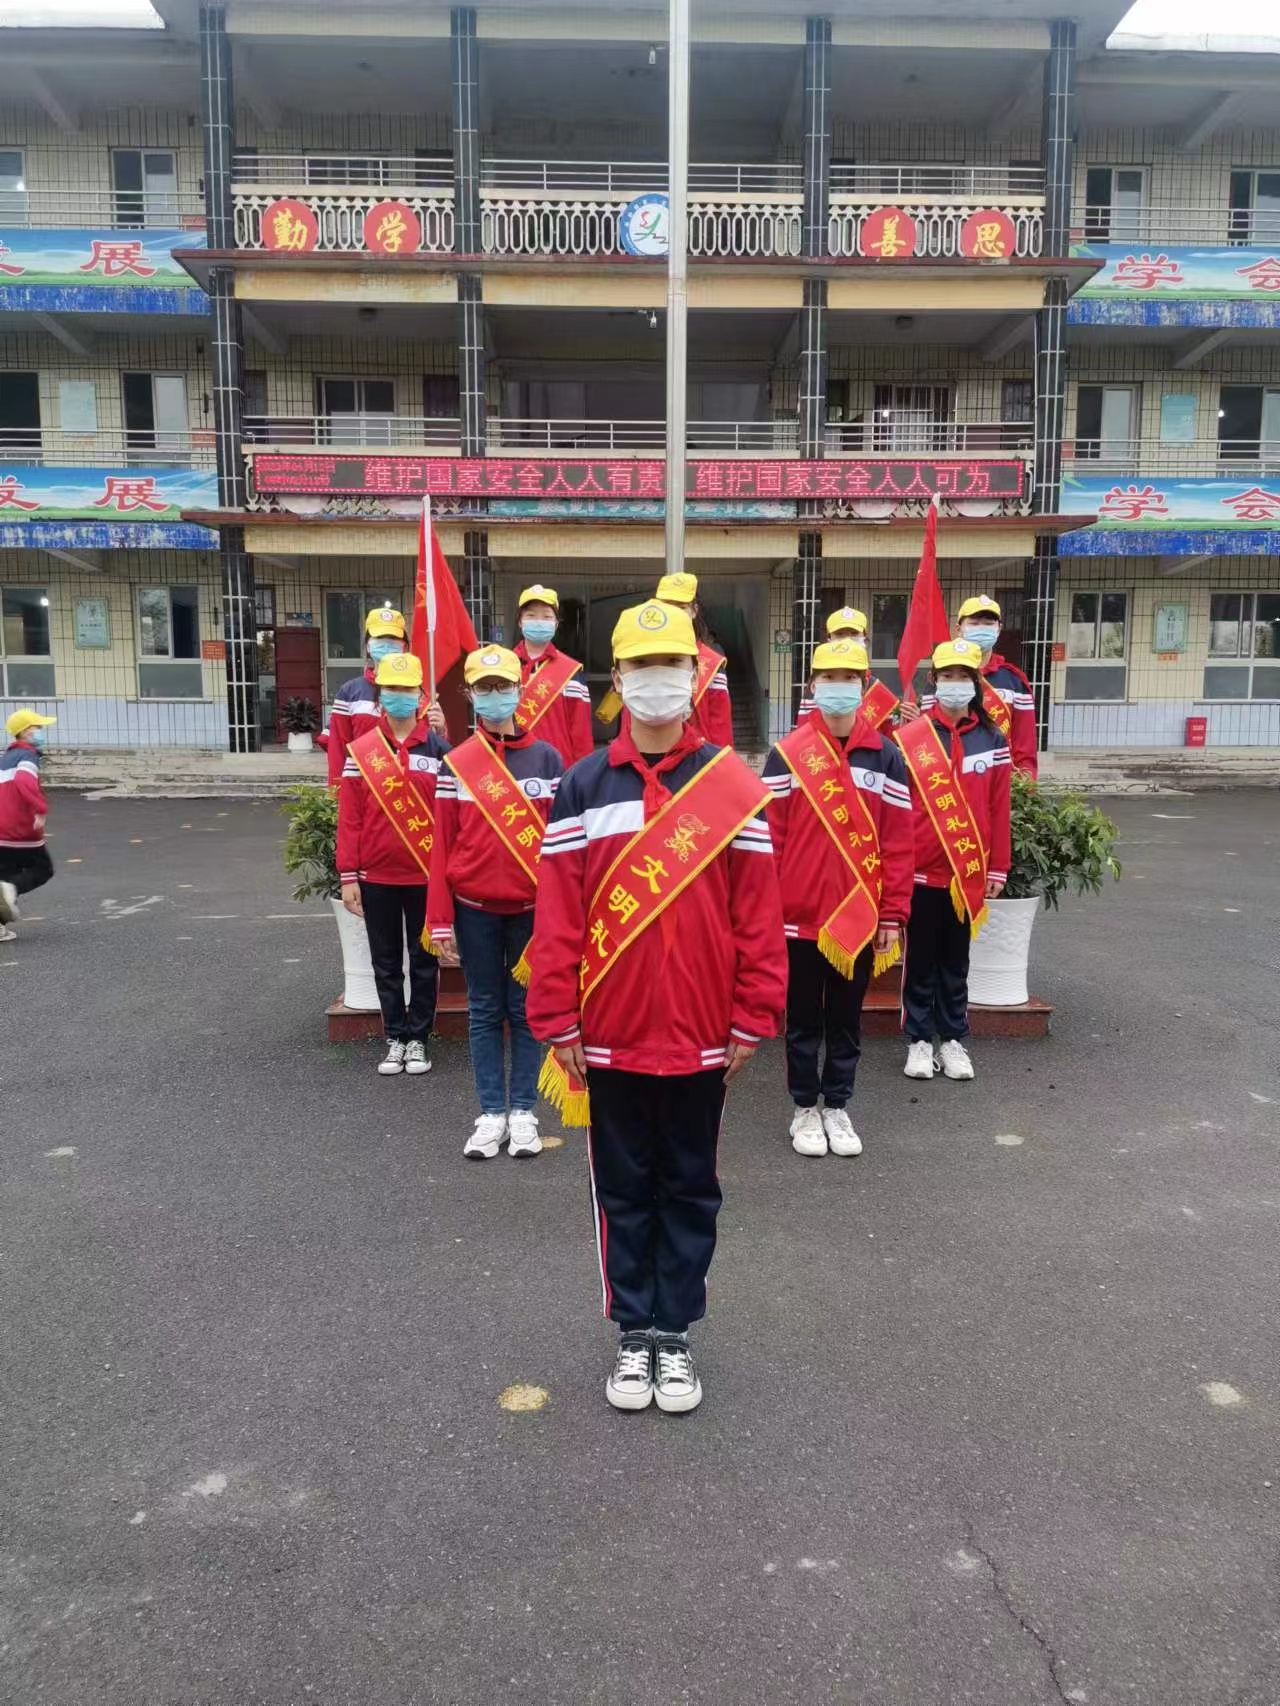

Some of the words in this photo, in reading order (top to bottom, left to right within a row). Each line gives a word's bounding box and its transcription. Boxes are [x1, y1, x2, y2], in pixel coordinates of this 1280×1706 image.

[364, 461, 664, 492] 维护国家安全人人有责
[696, 463, 990, 494] 维护国家安全人人可为
[1098, 484, 1280, 521] 学会
